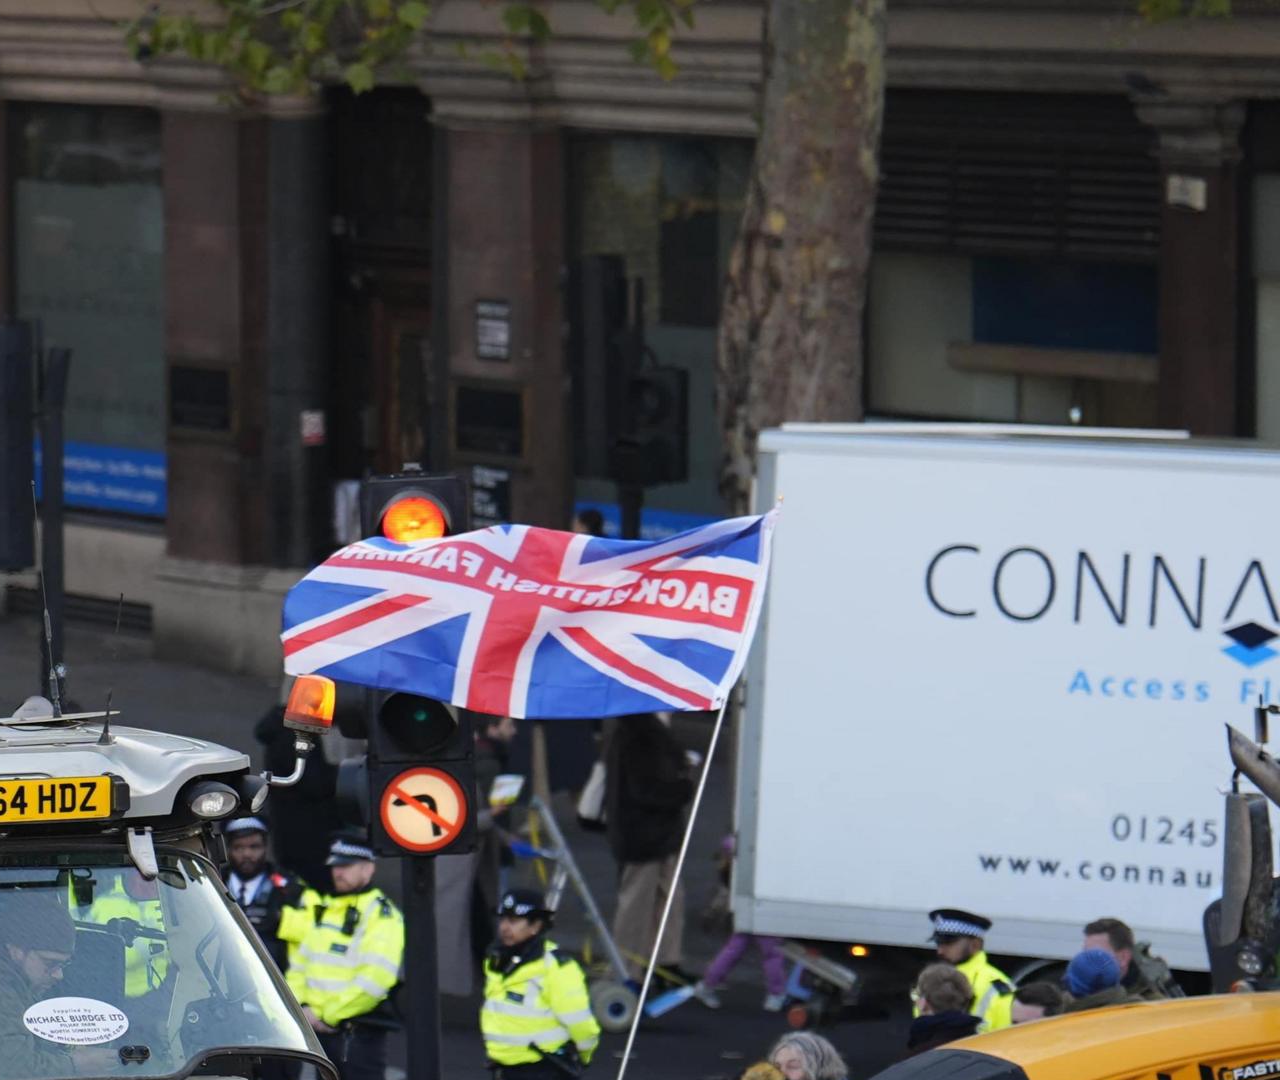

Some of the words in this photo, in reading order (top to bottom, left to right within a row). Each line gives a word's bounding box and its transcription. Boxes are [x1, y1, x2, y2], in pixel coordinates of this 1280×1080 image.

[1067, 669, 1210, 702] Access
[1239, 678, 1280, 705] Fl
[38, 781, 97, 814] HDZ
[1111, 813, 1218, 848] 01245
[978, 854, 1213, 889] www.connau
[25, 1015, 68, 1025] MICHAEL
[69, 1013, 107, 1023] BURDGE
[109, 1013, 125, 1022] LTD
